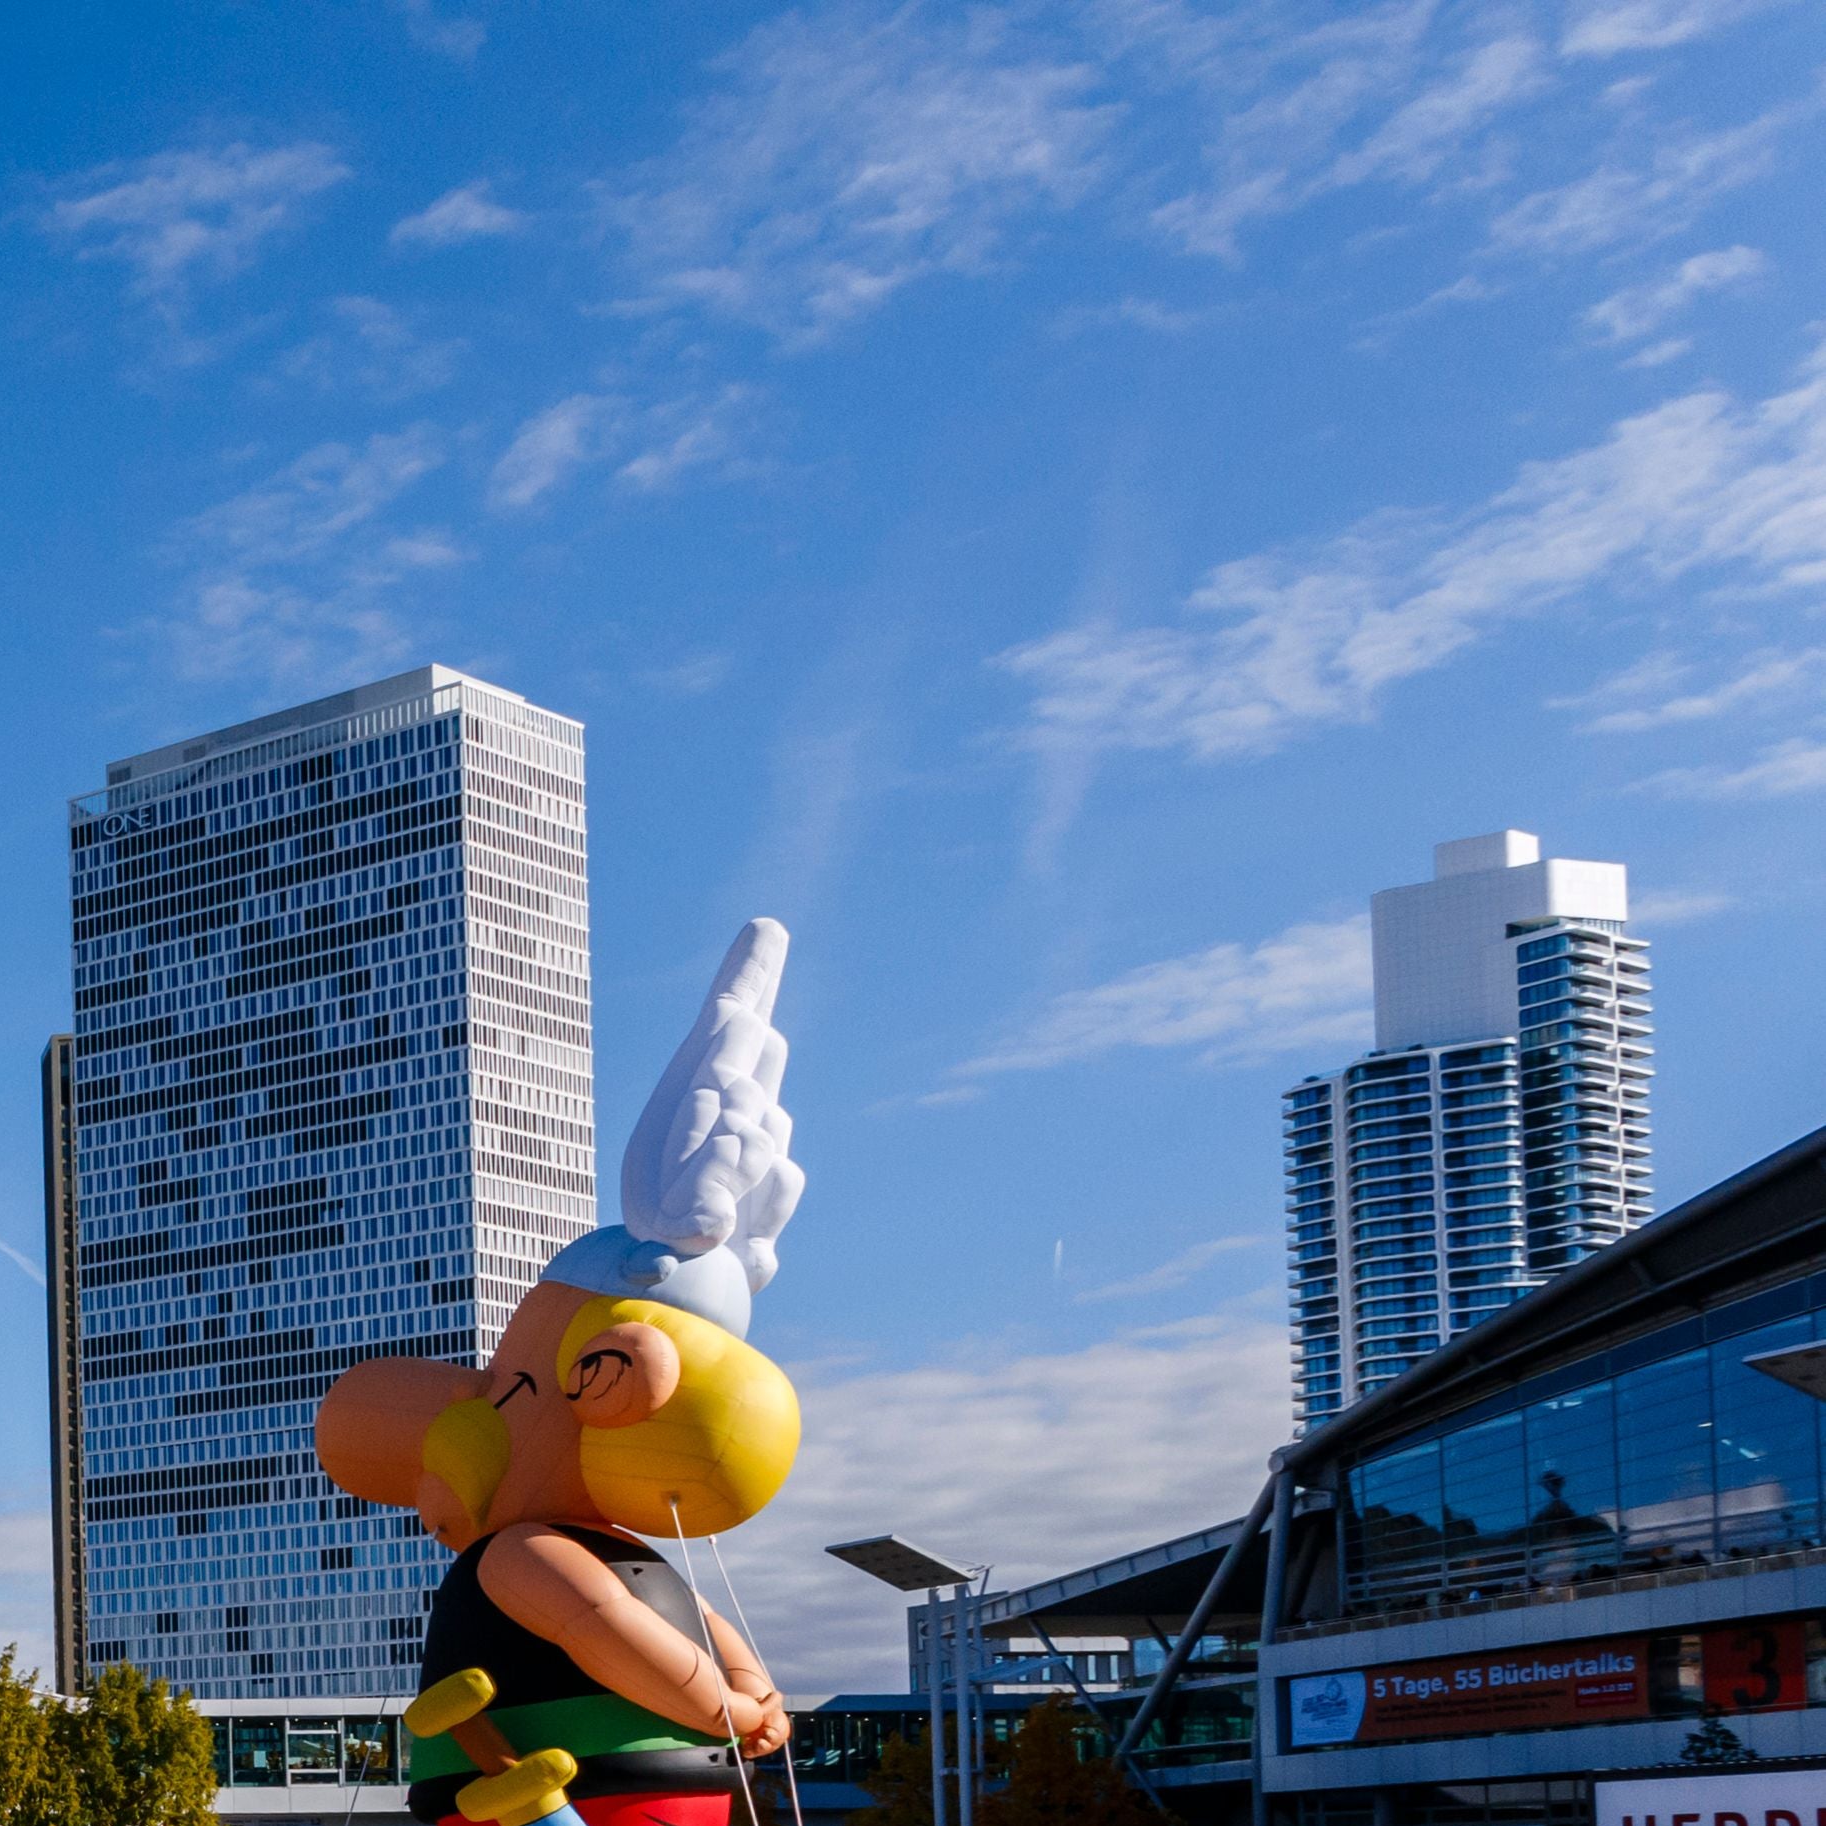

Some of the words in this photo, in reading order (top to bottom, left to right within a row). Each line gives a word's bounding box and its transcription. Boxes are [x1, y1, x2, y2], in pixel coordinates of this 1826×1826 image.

[1373, 1677, 1386, 1698] 5
[1390, 1674, 1449, 1700] Tage,
[1454, 1669, 1482, 1690] 55
[1488, 1653, 1635, 1688] Büchertalks
